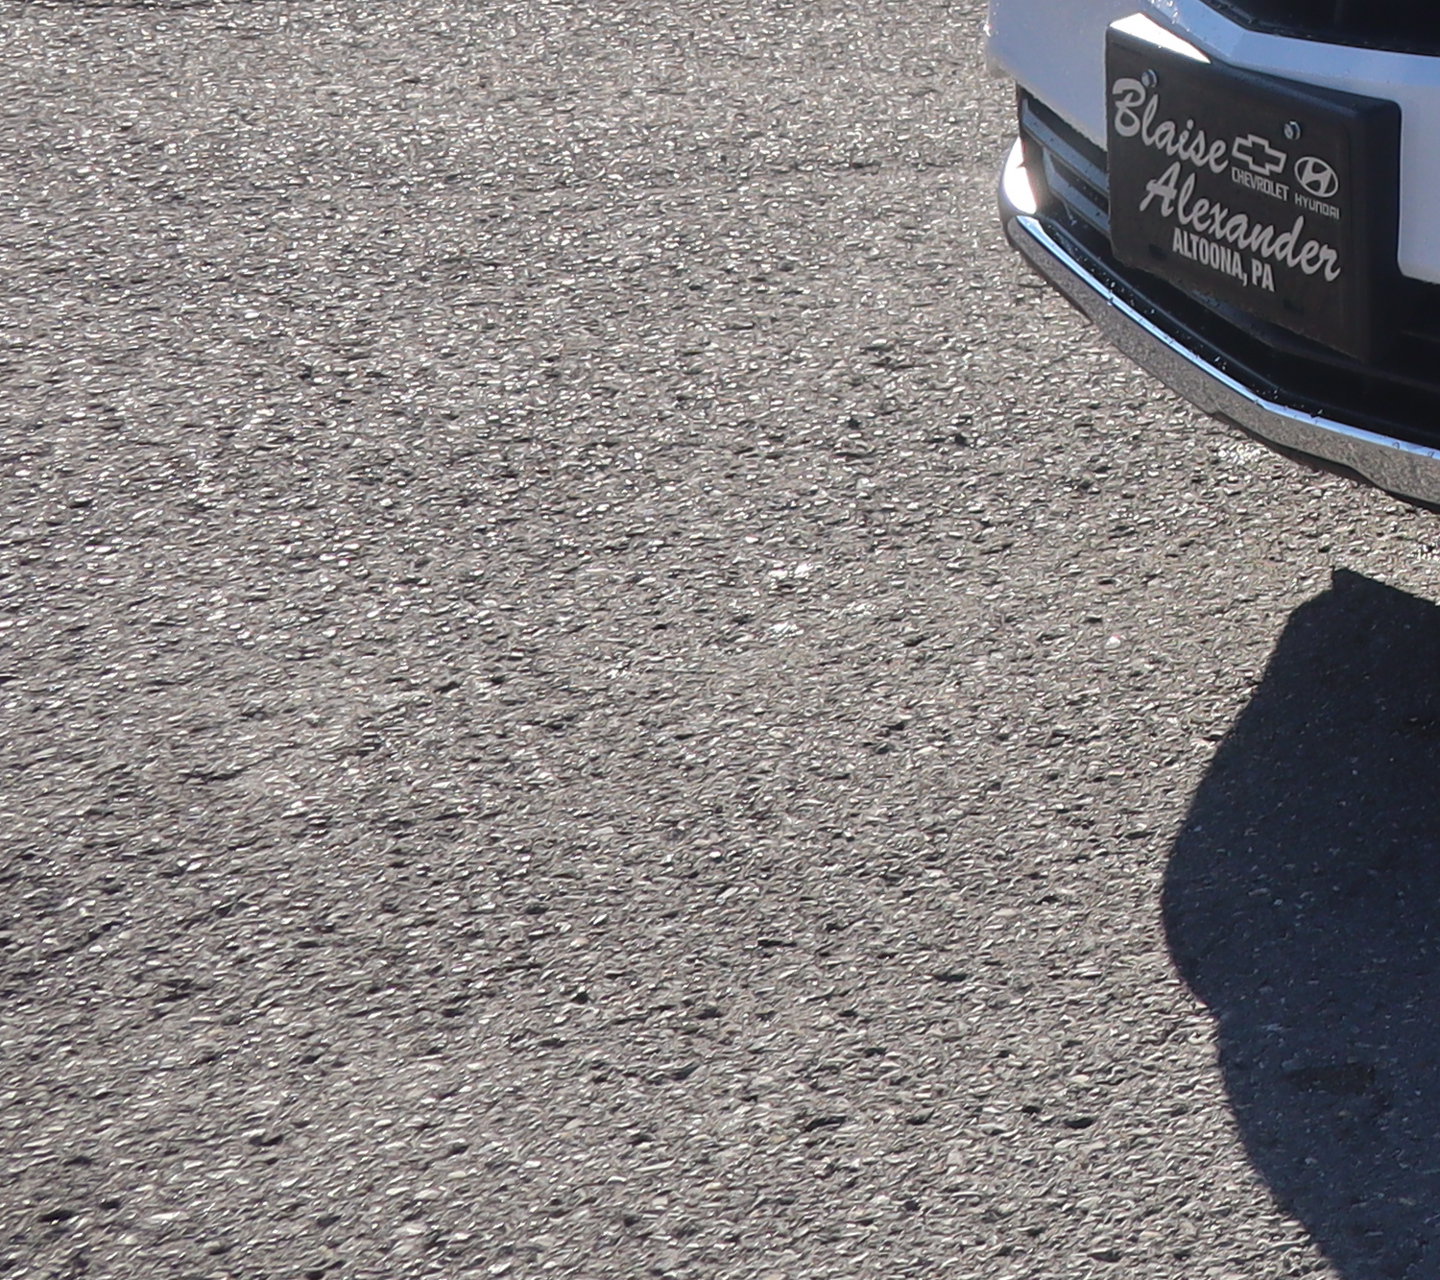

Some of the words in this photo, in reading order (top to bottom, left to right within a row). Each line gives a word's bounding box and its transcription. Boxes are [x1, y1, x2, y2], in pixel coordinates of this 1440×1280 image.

[1111, 77, 1229, 174] Blaise
[1231, 166, 1290, 202] CHEVROLET
[1294, 192, 1340, 220] HYUNDAI
[1139, 160, 1341, 282] Alexander
[1172, 227, 1248, 287] ALTOONA,
[1251, 258, 1275, 292] PA
